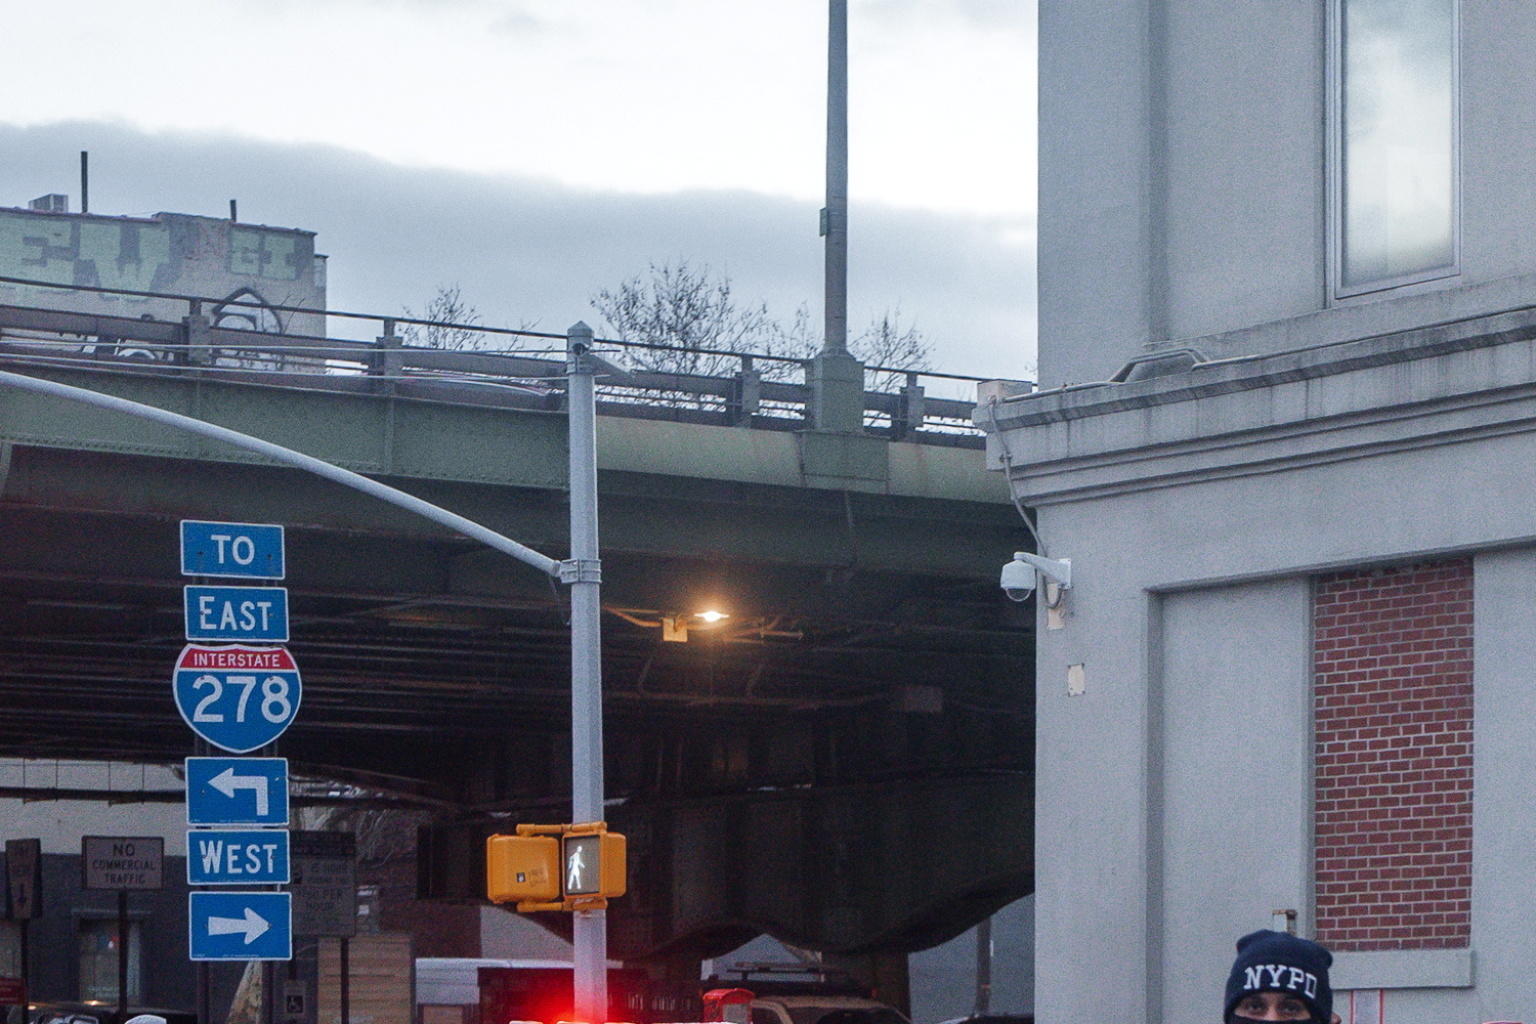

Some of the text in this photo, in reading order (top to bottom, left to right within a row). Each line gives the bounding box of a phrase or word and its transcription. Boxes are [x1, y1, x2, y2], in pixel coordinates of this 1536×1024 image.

[210, 534, 255, 565] TO
[198, 596, 273, 631] EAST
[193, 653, 280, 667] INTERSTATE
[192, 674, 291, 724] 278
[92, 859, 156, 871] COMMERCIAL
[112, 843, 136, 857] NO
[199, 839, 278, 874] WEST
[104, 873, 146, 885] TRAFFIC
[1243, 964, 1317, 999] NYPD
